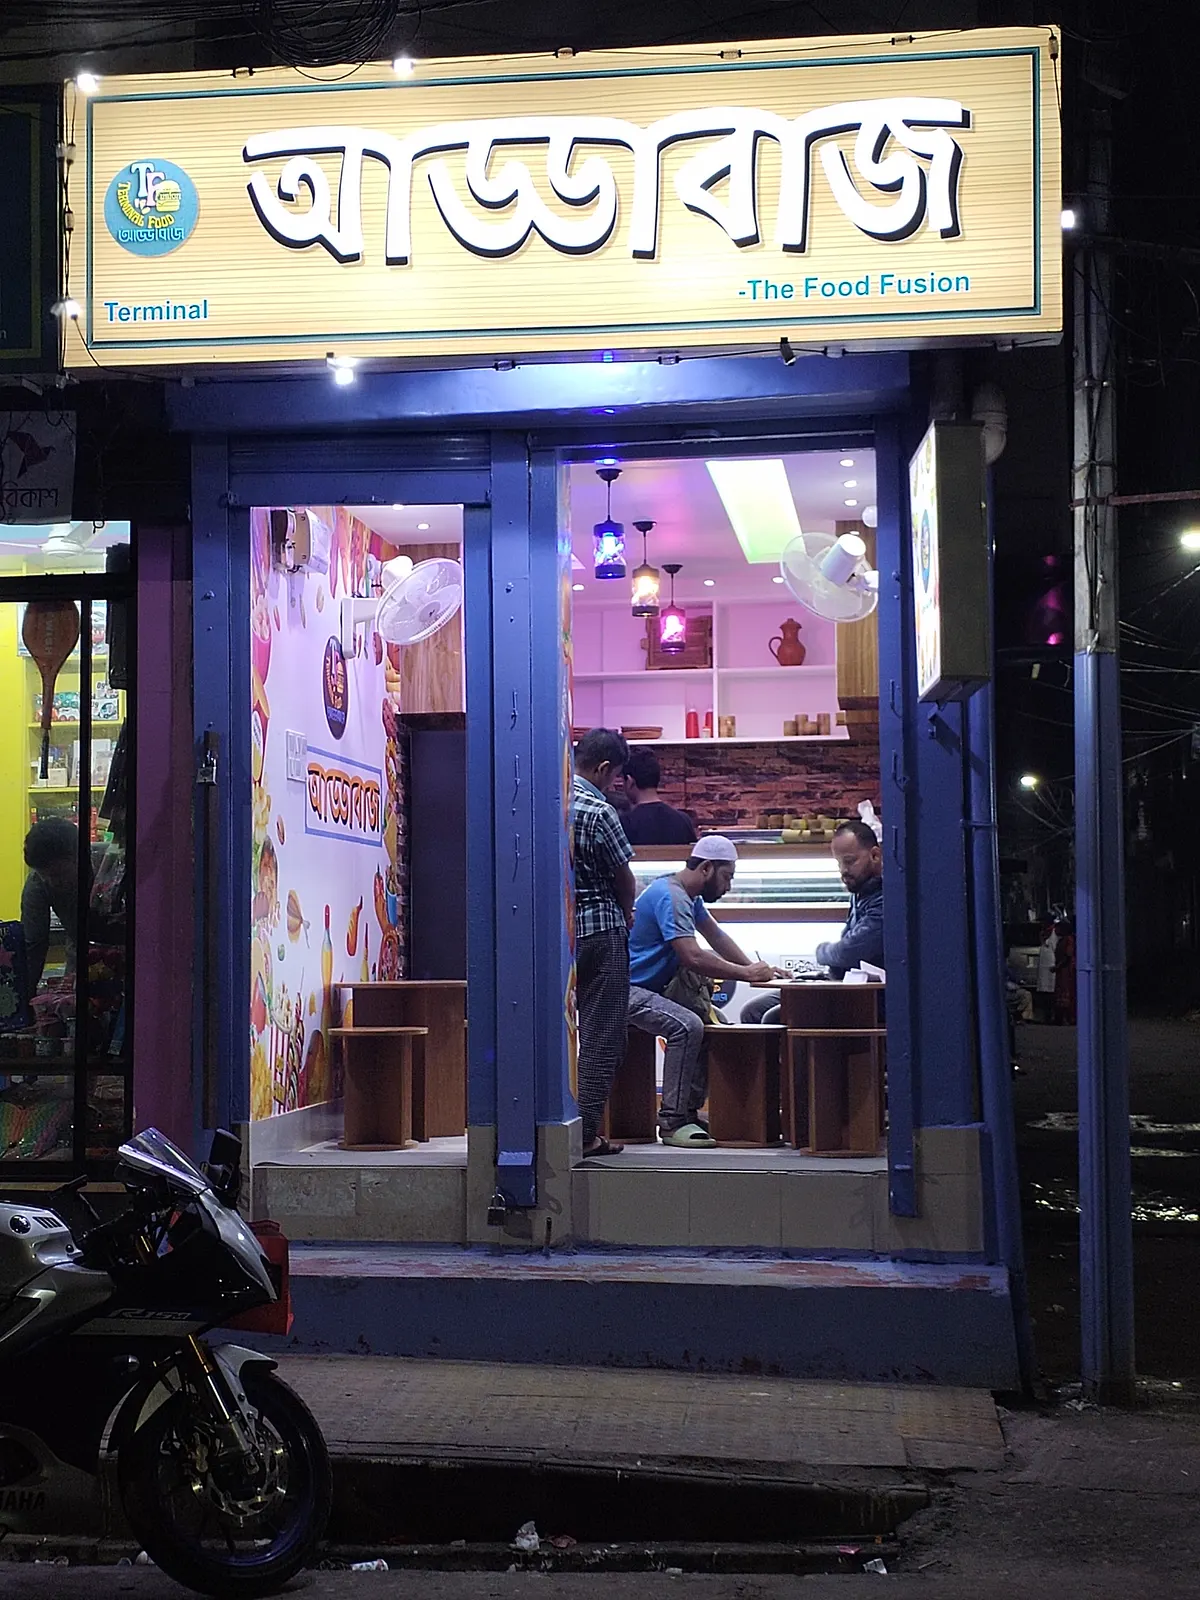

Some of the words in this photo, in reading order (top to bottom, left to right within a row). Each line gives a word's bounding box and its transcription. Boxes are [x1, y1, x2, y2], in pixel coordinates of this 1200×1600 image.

[241, 97, 972, 266] আড্ডাবাজ
[117, 180, 144, 227] TERMINAL
[148, 214, 175, 228] FOOD
[118, 227, 185, 242] আড্ডাবাজ
[805, 275, 870, 298] Food
[880, 272, 969, 295] Fusion
[104, 299, 207, 321] Terminal
[307, 763, 380, 833] আড্ডাবাজ
